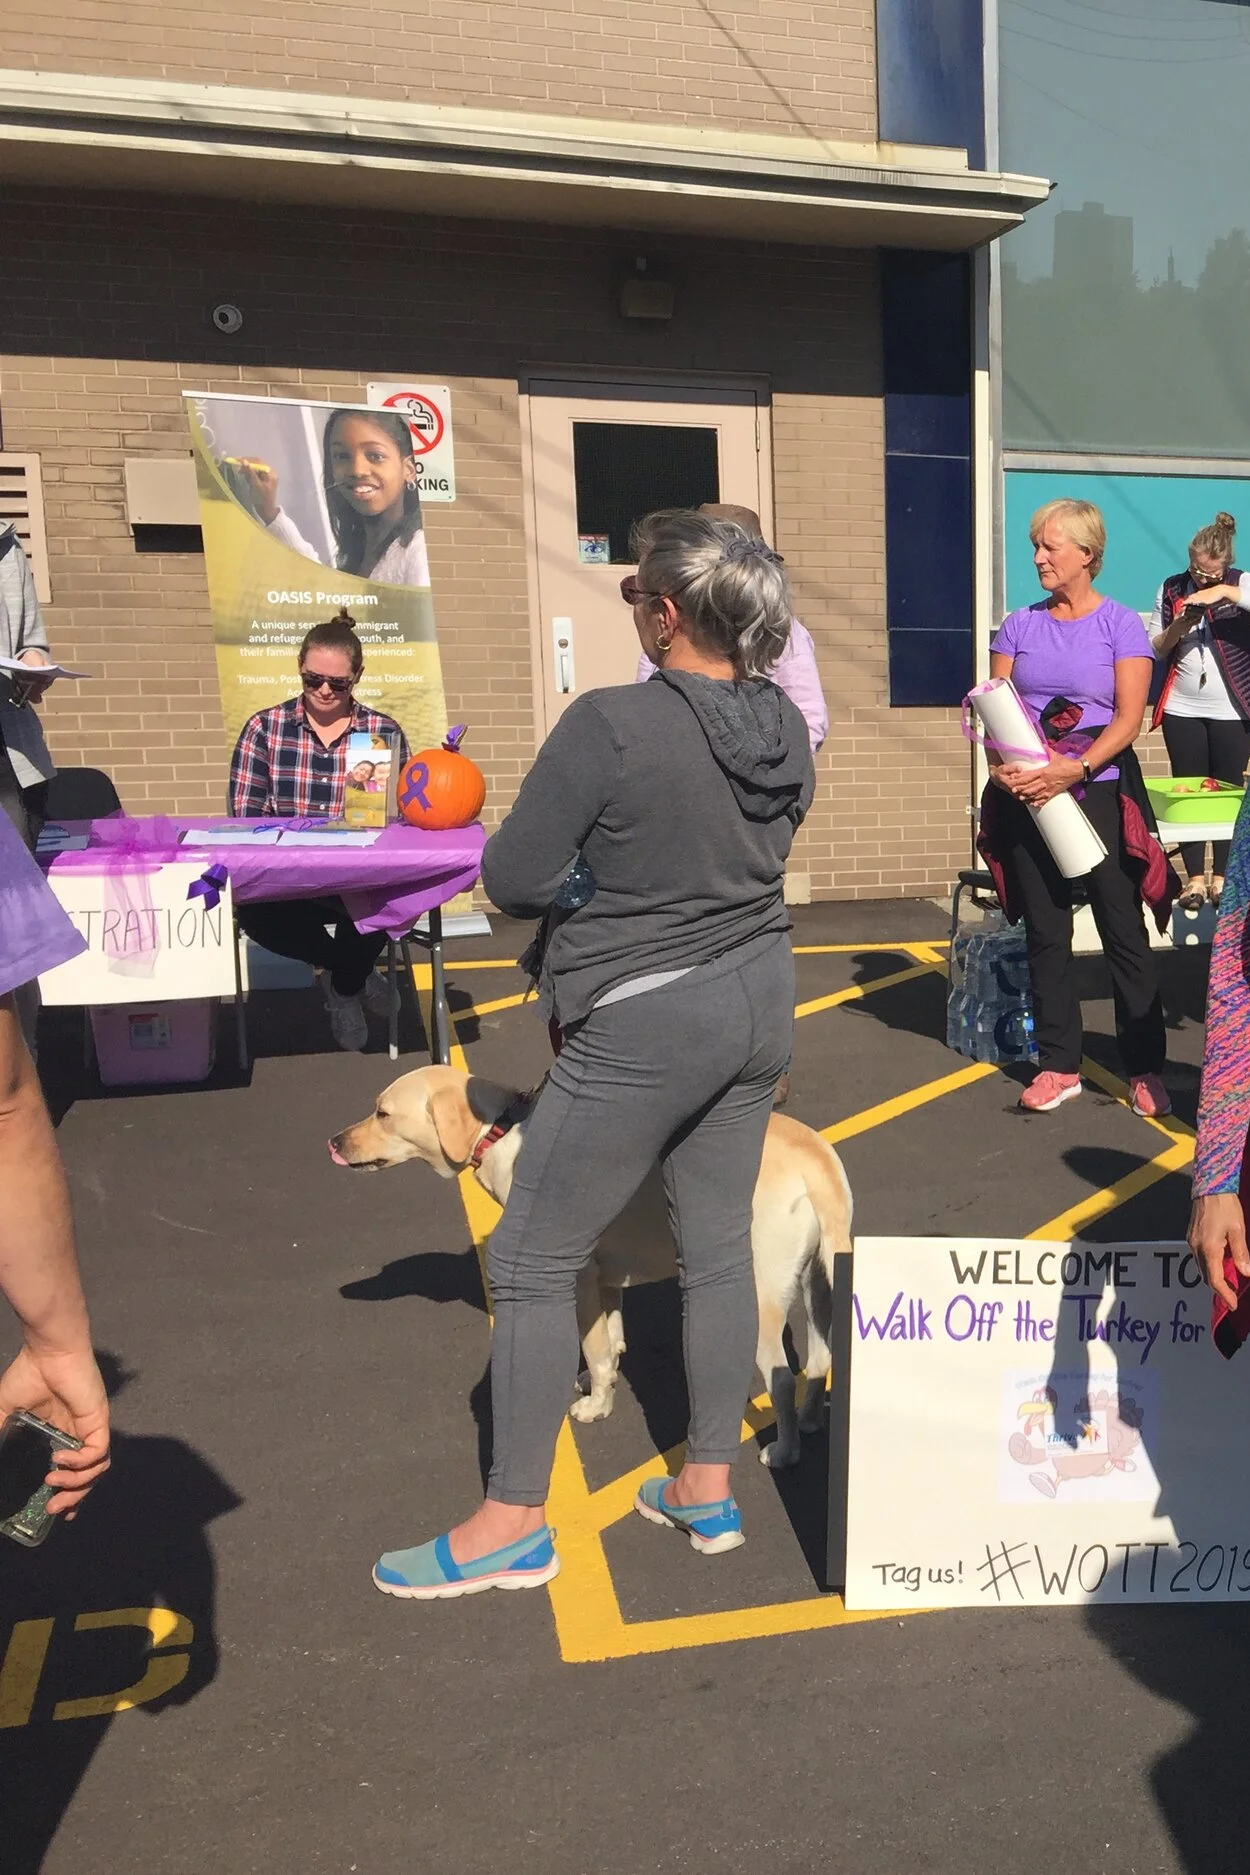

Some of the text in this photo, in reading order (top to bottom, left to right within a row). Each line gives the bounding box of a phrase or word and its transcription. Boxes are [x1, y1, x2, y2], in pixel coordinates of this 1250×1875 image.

[415, 462, 425, 475] O
[416, 478, 449, 492] KING
[267, 591, 378, 607] OASIS Program
[251, 620, 259, 630] A
[261, 620, 295, 631] unique
[354, 621, 399, 632] mmigrant
[248, 633, 268, 643] and
[270, 633, 305, 645] refuge
[387, 634, 404, 643] and
[240, 647, 416, 658] their famili xperienced:
[237, 675, 278, 685] Trauma,
[360, 674, 383, 683] tress
[385, 674, 424, 683] Disorder
[67, 906, 223, 953] TRATION
[949, 1250, 1138, 1288] WELCOME
[852, 1291, 933, 1341] Walk
[944, 1294, 1004, 1342] Off
[1013, 1300, 1056, 1342] the
[1063, 1293, 1160, 1365] Turkey
[1170, 1300, 1206, 1343] for
[871, 1563, 922, 1592] Tag
[927, 1560, 964, 1585] us!
